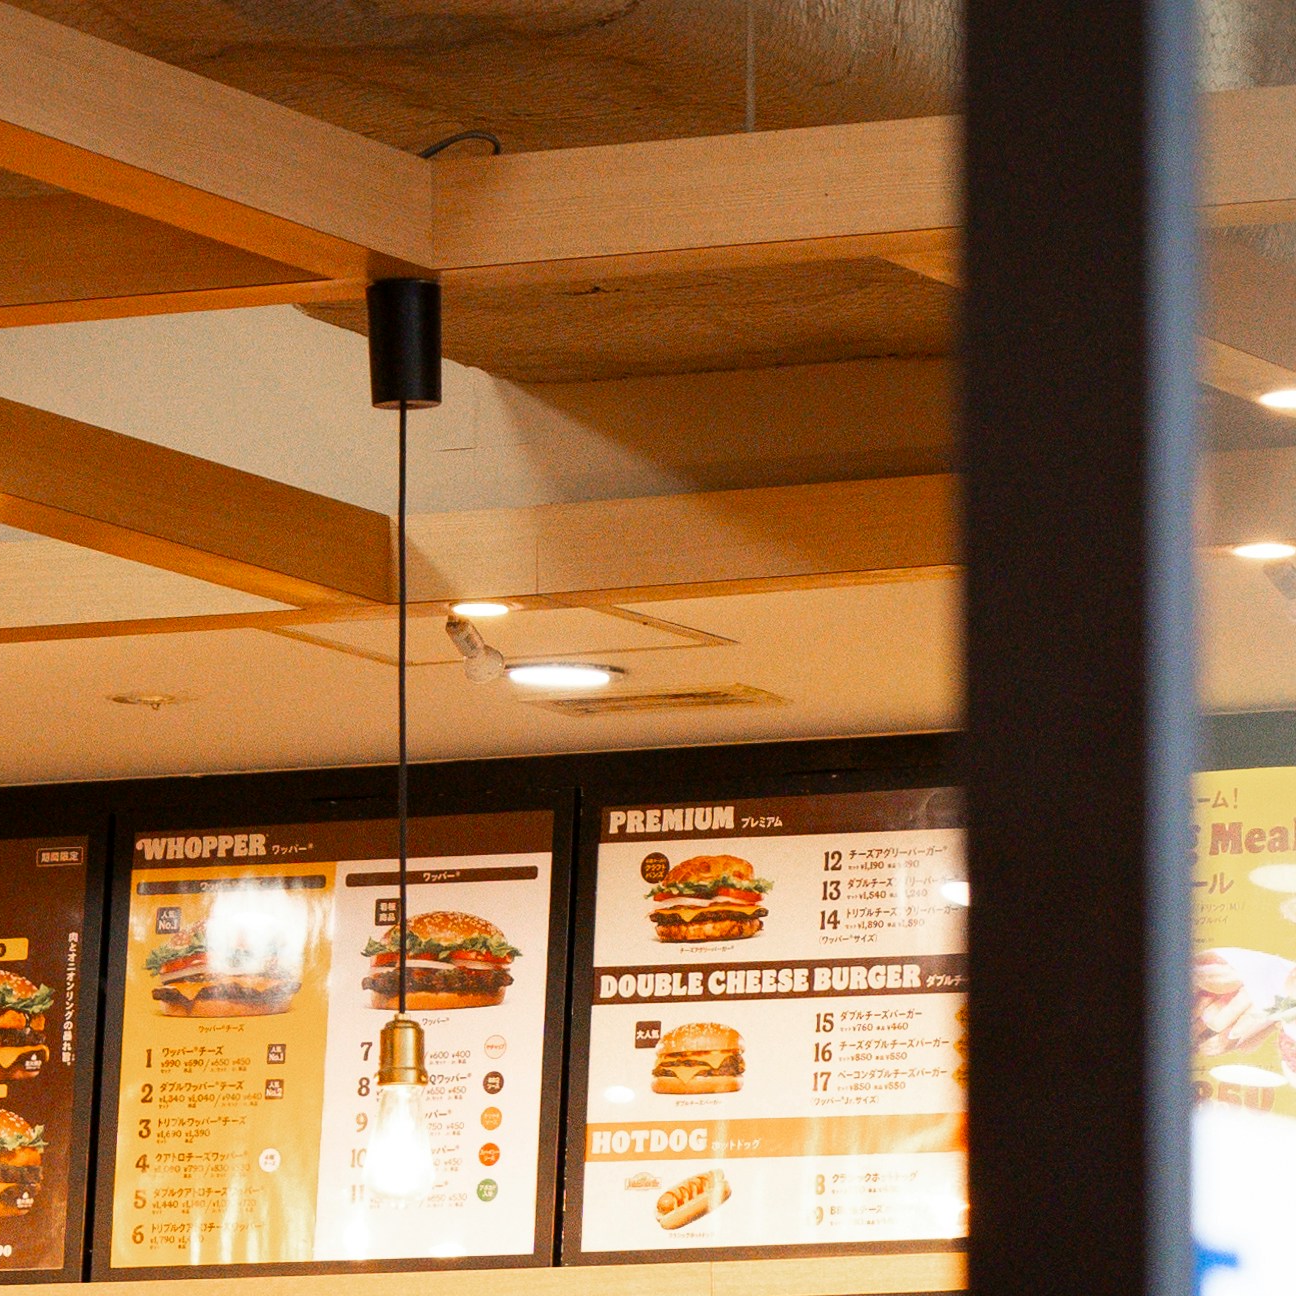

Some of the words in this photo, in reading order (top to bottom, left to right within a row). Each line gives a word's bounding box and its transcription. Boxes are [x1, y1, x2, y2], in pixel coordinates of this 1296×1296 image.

[609, 805, 735, 835] PREMIUM
[741, 816, 783, 829] プレミアム
[40, 850, 80, 863] 期間限定
[135, 833, 267, 861] WHOPPER
[823, 850, 843, 872] 12
[860, 860, 885, 870] ¥1,190
[821, 880, 842, 901] 13
[859, 890, 887, 900] ¥1,540
[158, 920, 177, 931] No.1
[819, 909, 841, 930] 14
[599, 972, 704, 999] DOUBLE
[707, 967, 810, 997] CHEESE
[813, 963, 921, 992] BURGER
[815, 1012, 835, 1033] 15
[840, 1008, 923, 1021] ダブルチーズバーガー
[145, 1048, 153, 1068] 1
[360, 1041, 373, 1062] 7
[814, 1041, 833, 1063] 16
[839, 1037, 950, 1051] チーズダブルチーズバーガー
[357, 1076, 371, 1097] 8
[811, 1071, 832, 1092] 17
[837, 1067, 948, 1080] ベーコンダブルチーズバーガー
[140, 1083, 153, 1104] 2
[138, 1118, 151, 1139] 3
[355, 1112, 369, 1133] 9
[591, 1127, 708, 1155] HOTDOG
[135, 1153, 150, 1174] 4
[133, 1189, 147, 1209] 5
[132, 1225, 144, 1245] 6
